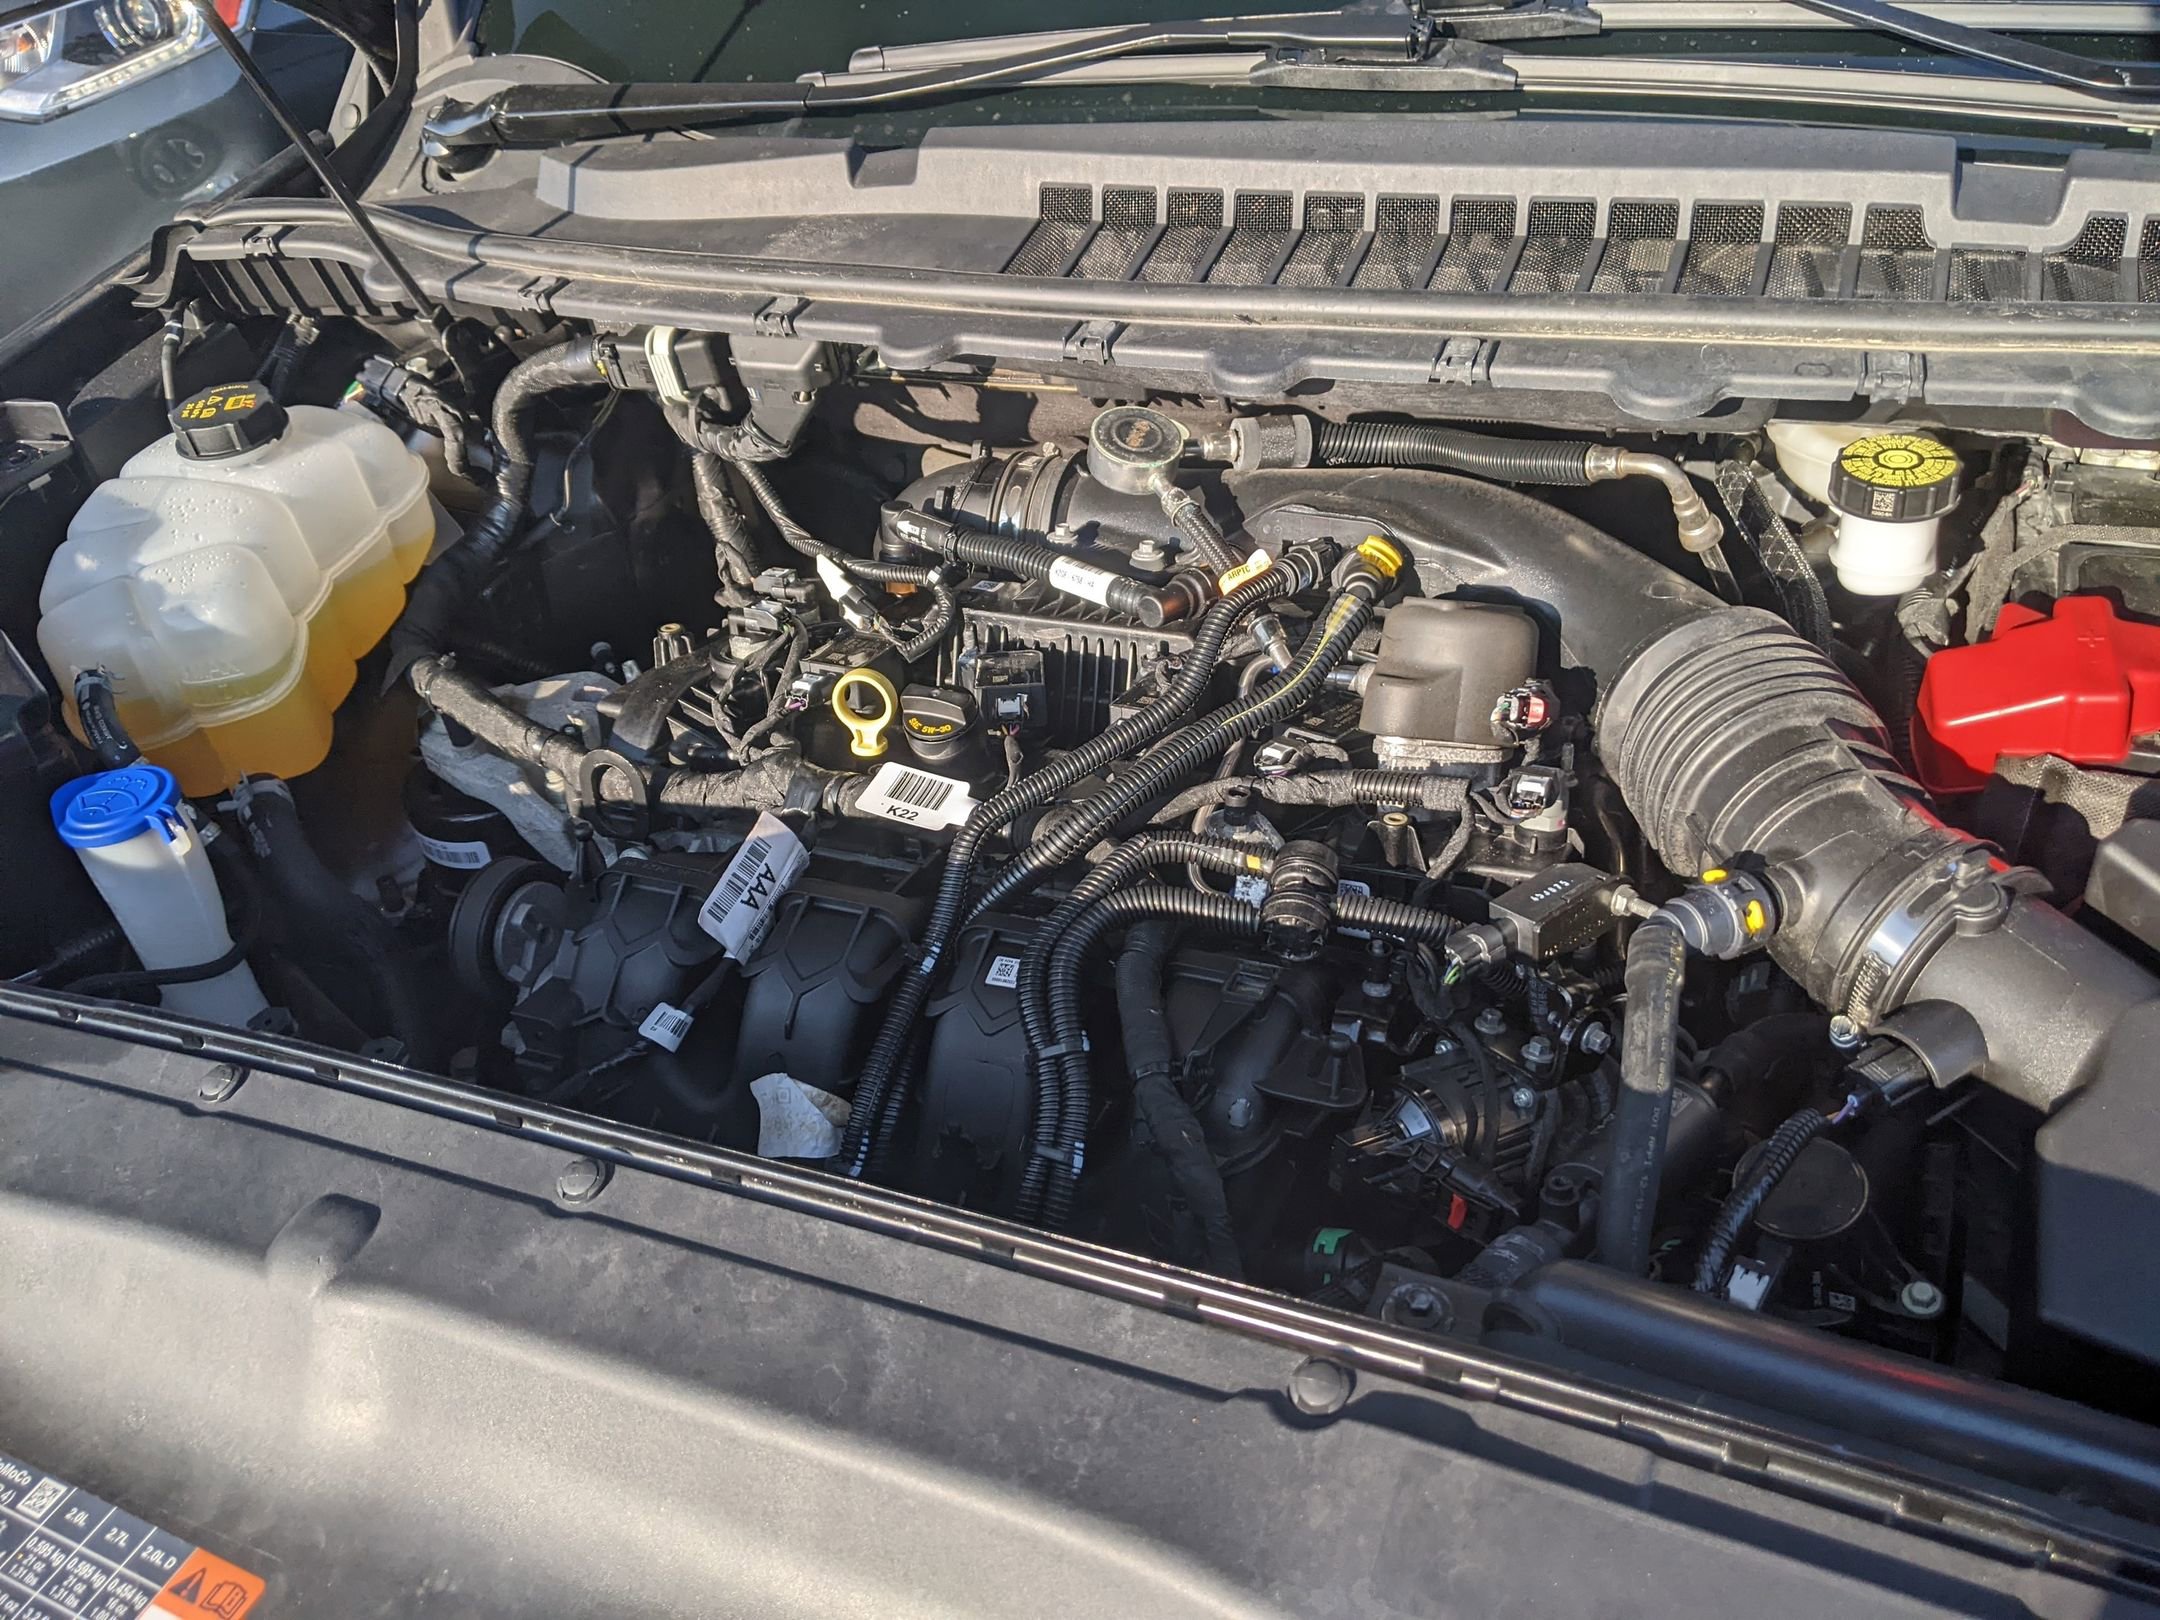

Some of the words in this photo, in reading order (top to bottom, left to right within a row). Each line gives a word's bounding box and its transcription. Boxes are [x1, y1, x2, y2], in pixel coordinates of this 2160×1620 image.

[909, 717, 923, 730] SAE
[921, 724, 952, 734] 5W-30
[886, 805, 919, 821] K22
[740, 862, 776, 910] AAA
[0, 1457, 32, 1486] oMoCo
[64, 1507, 89, 1527] 2.0L
[104, 1527, 129, 1548] 2.7L
[22, 1553, 37, 1567] 21
[32, 1561, 46, 1573] oz
[25, 1536, 56, 1558] 0.595
[49, 1548, 66, 1568] kg
[140, 1545, 166, 1566] 2.0L
[163, 1556, 177, 1570] D
[9, 1564, 28, 1579] 1.31
[23, 1571, 39, 1586] lbs
[62, 1574, 78, 1588] 21
[73, 1582, 87, 1594] oz
[66, 1557, 97, 1579] 0.595
[90, 1569, 107, 1590] kg
[49, 1585, 69, 1601] 1.31
[64, 1593, 80, 1609] lbs
[107, 1578, 138, 1601] 0.454
[131, 1590, 148, 1611] kg
[106, 1597, 120, 1610] 16
[115, 1604, 128, 1617] oz
